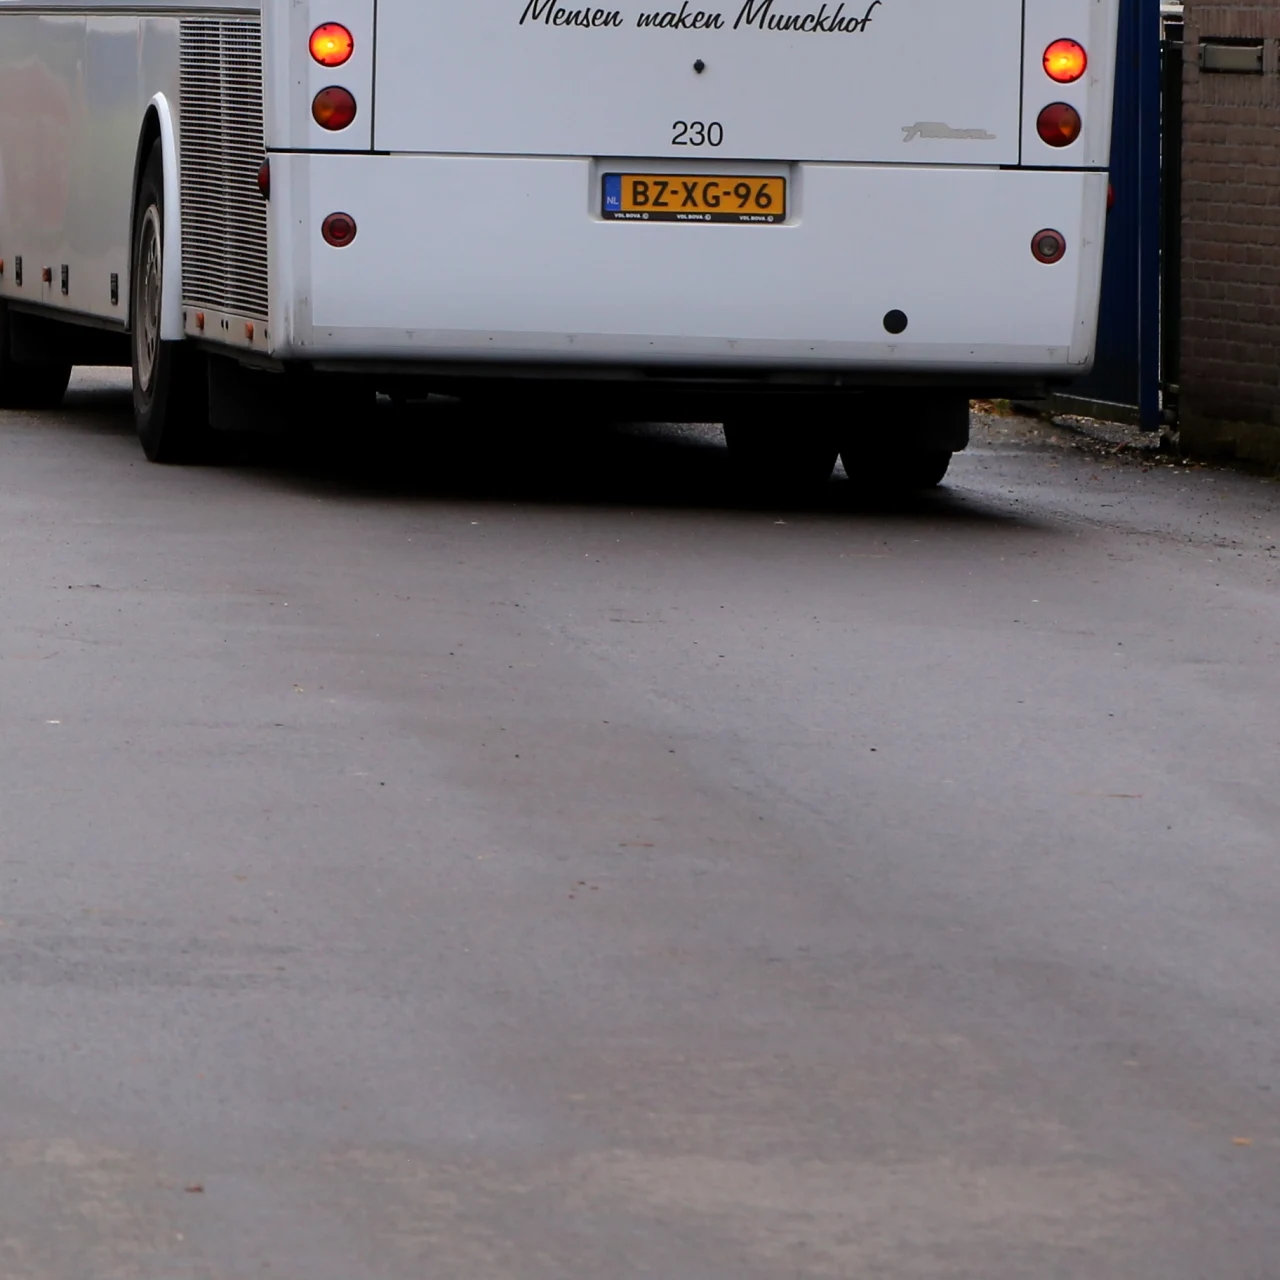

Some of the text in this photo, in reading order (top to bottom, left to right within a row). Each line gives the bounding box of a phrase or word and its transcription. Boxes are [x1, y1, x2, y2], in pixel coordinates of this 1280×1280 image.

[636, 0, 725, 30] maken
[671, 120, 724, 147] 230
[606, 196, 619, 205] NL
[632, 180, 773, 209] BZ-XG-96
